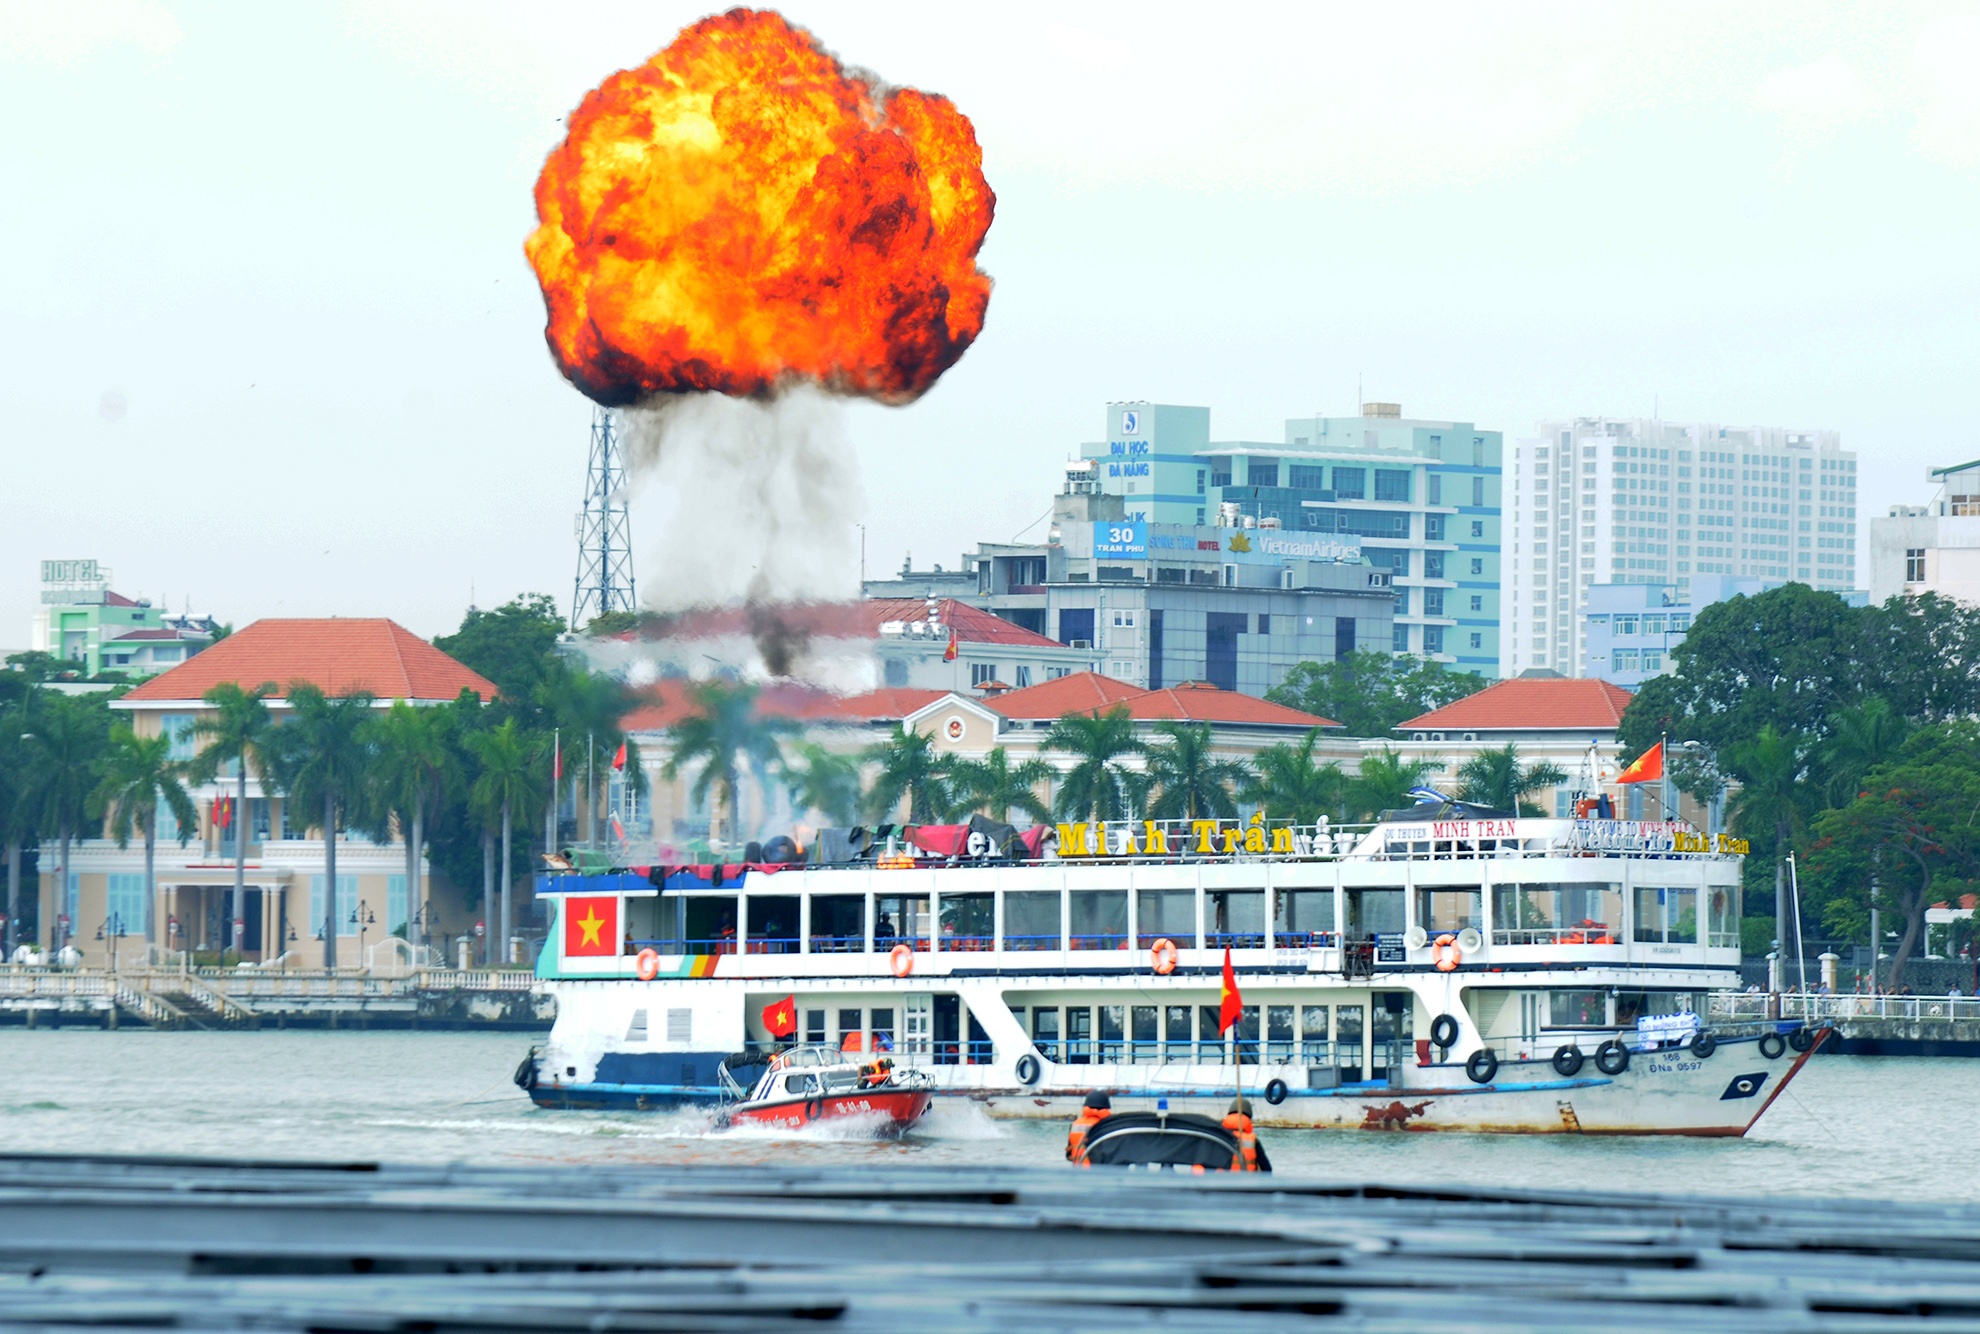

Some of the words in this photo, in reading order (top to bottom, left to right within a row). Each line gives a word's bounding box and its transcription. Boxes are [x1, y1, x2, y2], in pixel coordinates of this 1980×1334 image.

[1109, 528, 1133, 543] 30
[1198, 540, 1220, 551] HOTEL
[41, 559, 104, 582] HOTEL
[1433, 821, 1470, 838] MINH
[1477, 820, 1516, 837] TRAN
[1673, 831, 1710, 852] Minh
[1717, 833, 1750, 854] Tran
